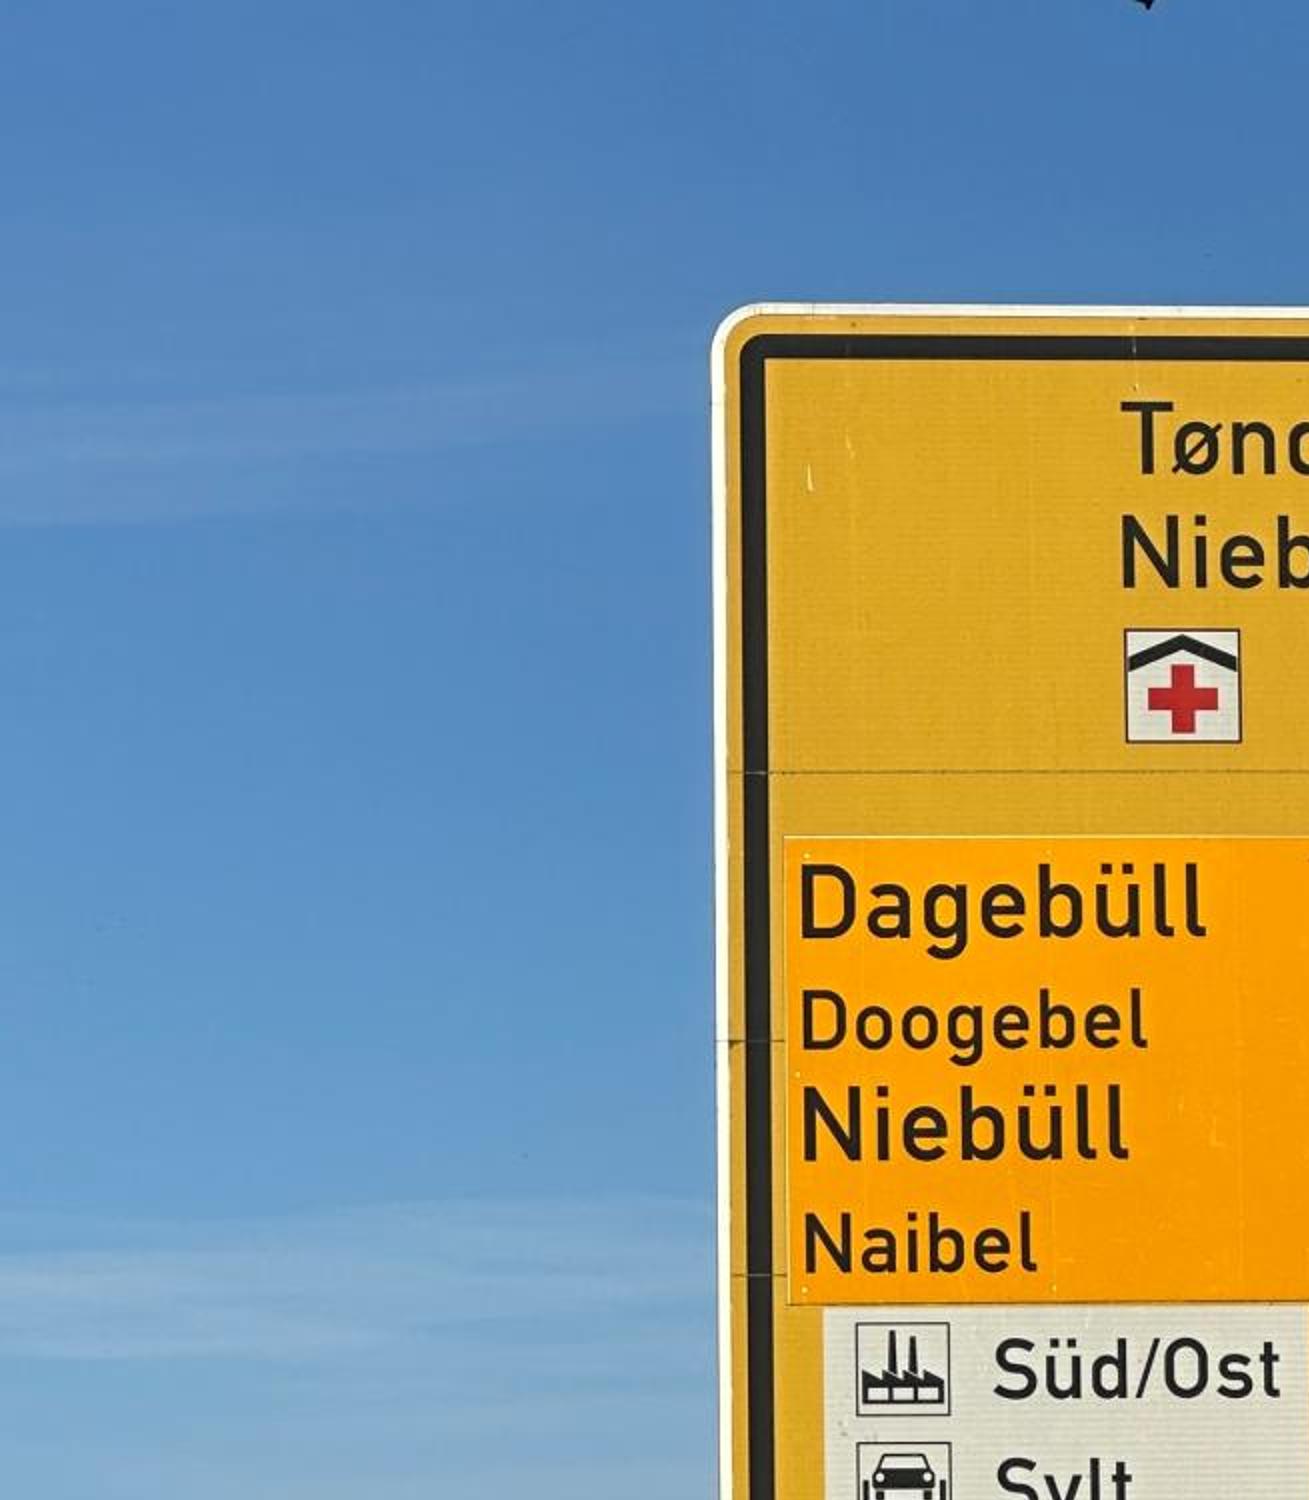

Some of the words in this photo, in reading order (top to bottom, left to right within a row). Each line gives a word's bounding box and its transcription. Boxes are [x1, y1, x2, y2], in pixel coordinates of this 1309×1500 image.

[801, 862, 1207, 960] Dagebüll
[802, 987, 1148, 1067] Doogebel
[803, 1084, 1129, 1162] Niebüll
[805, 1211, 1038, 1274] Naibel
[994, 1337, 1280, 1400] Süd/Ost
